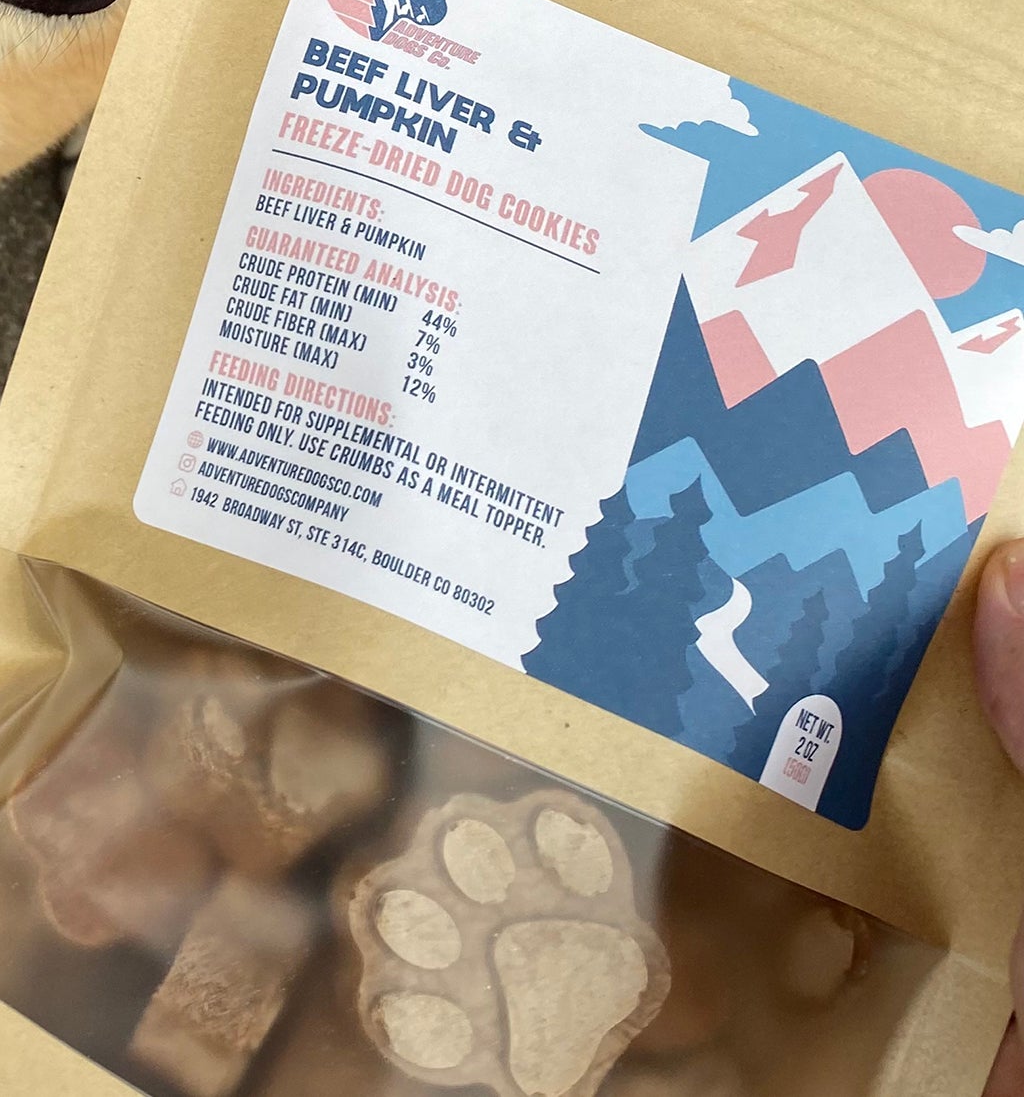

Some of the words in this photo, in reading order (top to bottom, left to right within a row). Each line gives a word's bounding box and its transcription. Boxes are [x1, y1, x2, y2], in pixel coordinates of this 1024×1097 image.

[381, 31, 428, 57] DOGS
[393, 20, 481, 64] ADVENTURE
[290, 72, 458, 154] PUMPKIN
[302, 37, 389, 84] BEEF
[394, 71, 496, 134] LIVER
[507, 120, 542, 152] &
[262, 168, 384, 222] INGREDIENTS:
[278, 111, 441, 187] FREEZE-DRIED
[445, 170, 494, 210] DOG
[498, 193, 600, 256] COOKIES
[255, 194, 292, 217] BEEF
[293, 204, 336, 231] LIVER
[340, 217, 351, 234] &
[354, 221, 426, 261] PUMPKIN
[239, 252, 285, 279] CRUDE
[287, 262, 349, 298] PROTEIN
[353, 284, 398, 312] (MIN)
[421, 310, 458, 337] 44%
[245, 225, 360, 275] GUARANTEED
[364, 259, 462, 315] ANALYSIS:
[226, 297, 272, 324] CRUDE
[274, 308, 314, 337] FIBER
[319, 323, 367, 352] (MAX)
[407, 352, 434, 376] 3%
[232, 274, 279, 301] CRUDE
[280, 286, 308, 308] FAT
[310, 296, 353, 323] (MIN)
[415, 329, 441, 354] 7%
[209, 350, 280, 391] FEEDING
[284, 372, 396, 427] DIRECTIONS:
[219, 319, 291, 355] MOISTURE
[293, 341, 339, 369] (MAX)
[402, 375, 436, 403] 12%
[195, 400, 254, 434] FEEDING
[256, 420, 295, 449] ONLY.
[298, 433, 329, 457] USE
[329, 444, 394, 479] CRUMBS
[396, 466, 420, 489] AS
[421, 477, 433, 496] A
[437, 483, 479, 518] MEAL
[485, 504, 546, 548] TOPPER.
[198, 461, 350, 522] ADVENTUREDOGSCOMPANY
[202, 377, 272, 415] INTENDED
[274, 401, 302, 425] FOR
[306, 410, 420, 465] SUPPLEMENTAL
[425, 452, 448, 476] OR
[450, 462, 565, 528] INTERMITTENT
[206, 437, 384, 508] WWW.ADVENTUREDOGSCO.COM
[190, 487, 219, 508] 1942
[222, 497, 286, 530] BROADWAY
[286, 519, 302, 539] ST,
[306, 526, 329, 546] STE
[331, 534, 367, 562] 314C,
[371, 549, 432, 587] BOULDER
[433, 576, 450, 595] CO
[453, 584, 495, 615] 80302
[795, 708, 819, 734] NET
[816, 719, 834, 744] WT.
[795, 736, 806, 755] 2
[803, 740, 819, 762] OZ
